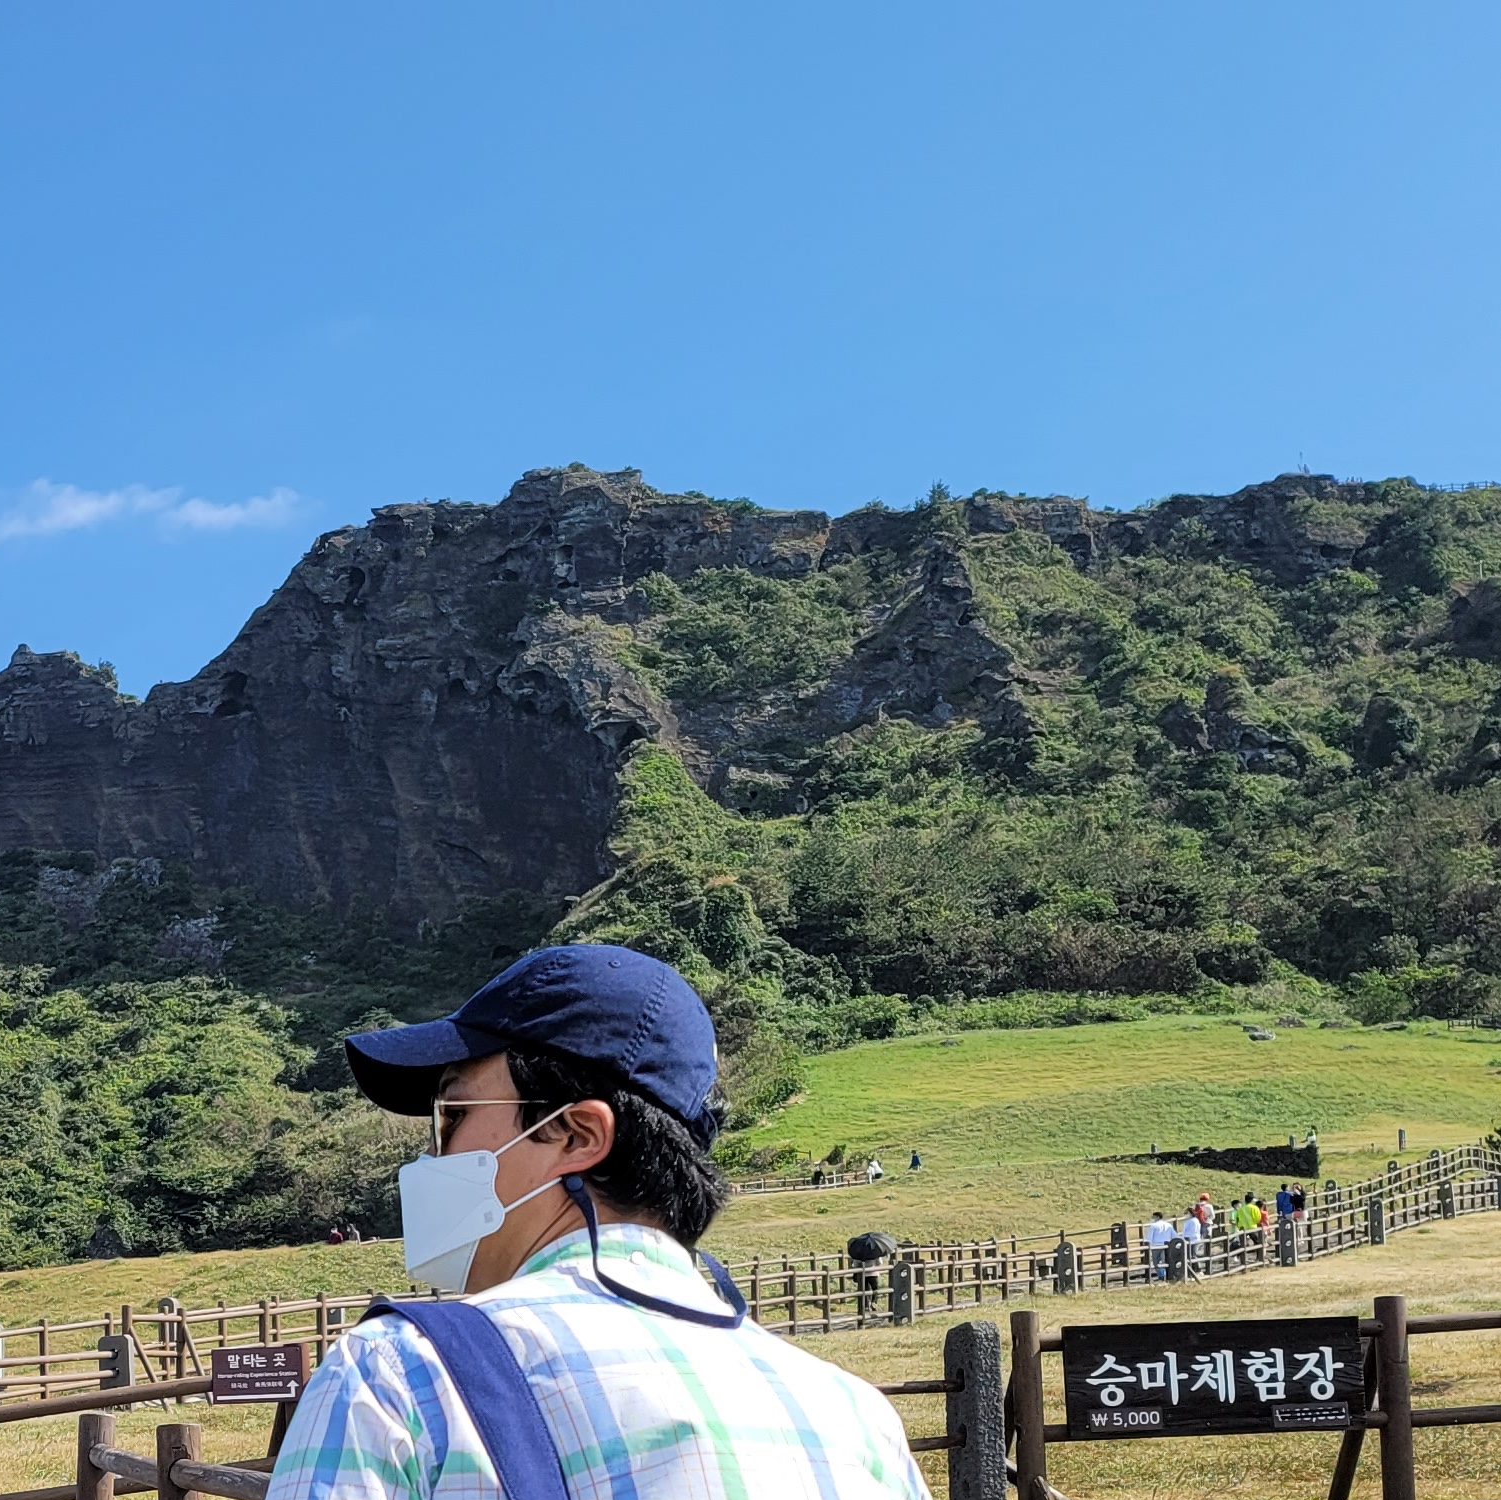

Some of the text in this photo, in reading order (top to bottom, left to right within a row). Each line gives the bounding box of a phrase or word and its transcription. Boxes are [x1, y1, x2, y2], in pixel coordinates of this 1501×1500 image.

[273, 1353, 286, 1367] 곳
[1085, 1346, 1345, 1406] 승마체험장
[1112, 1411, 1160, 1428] 5,000
